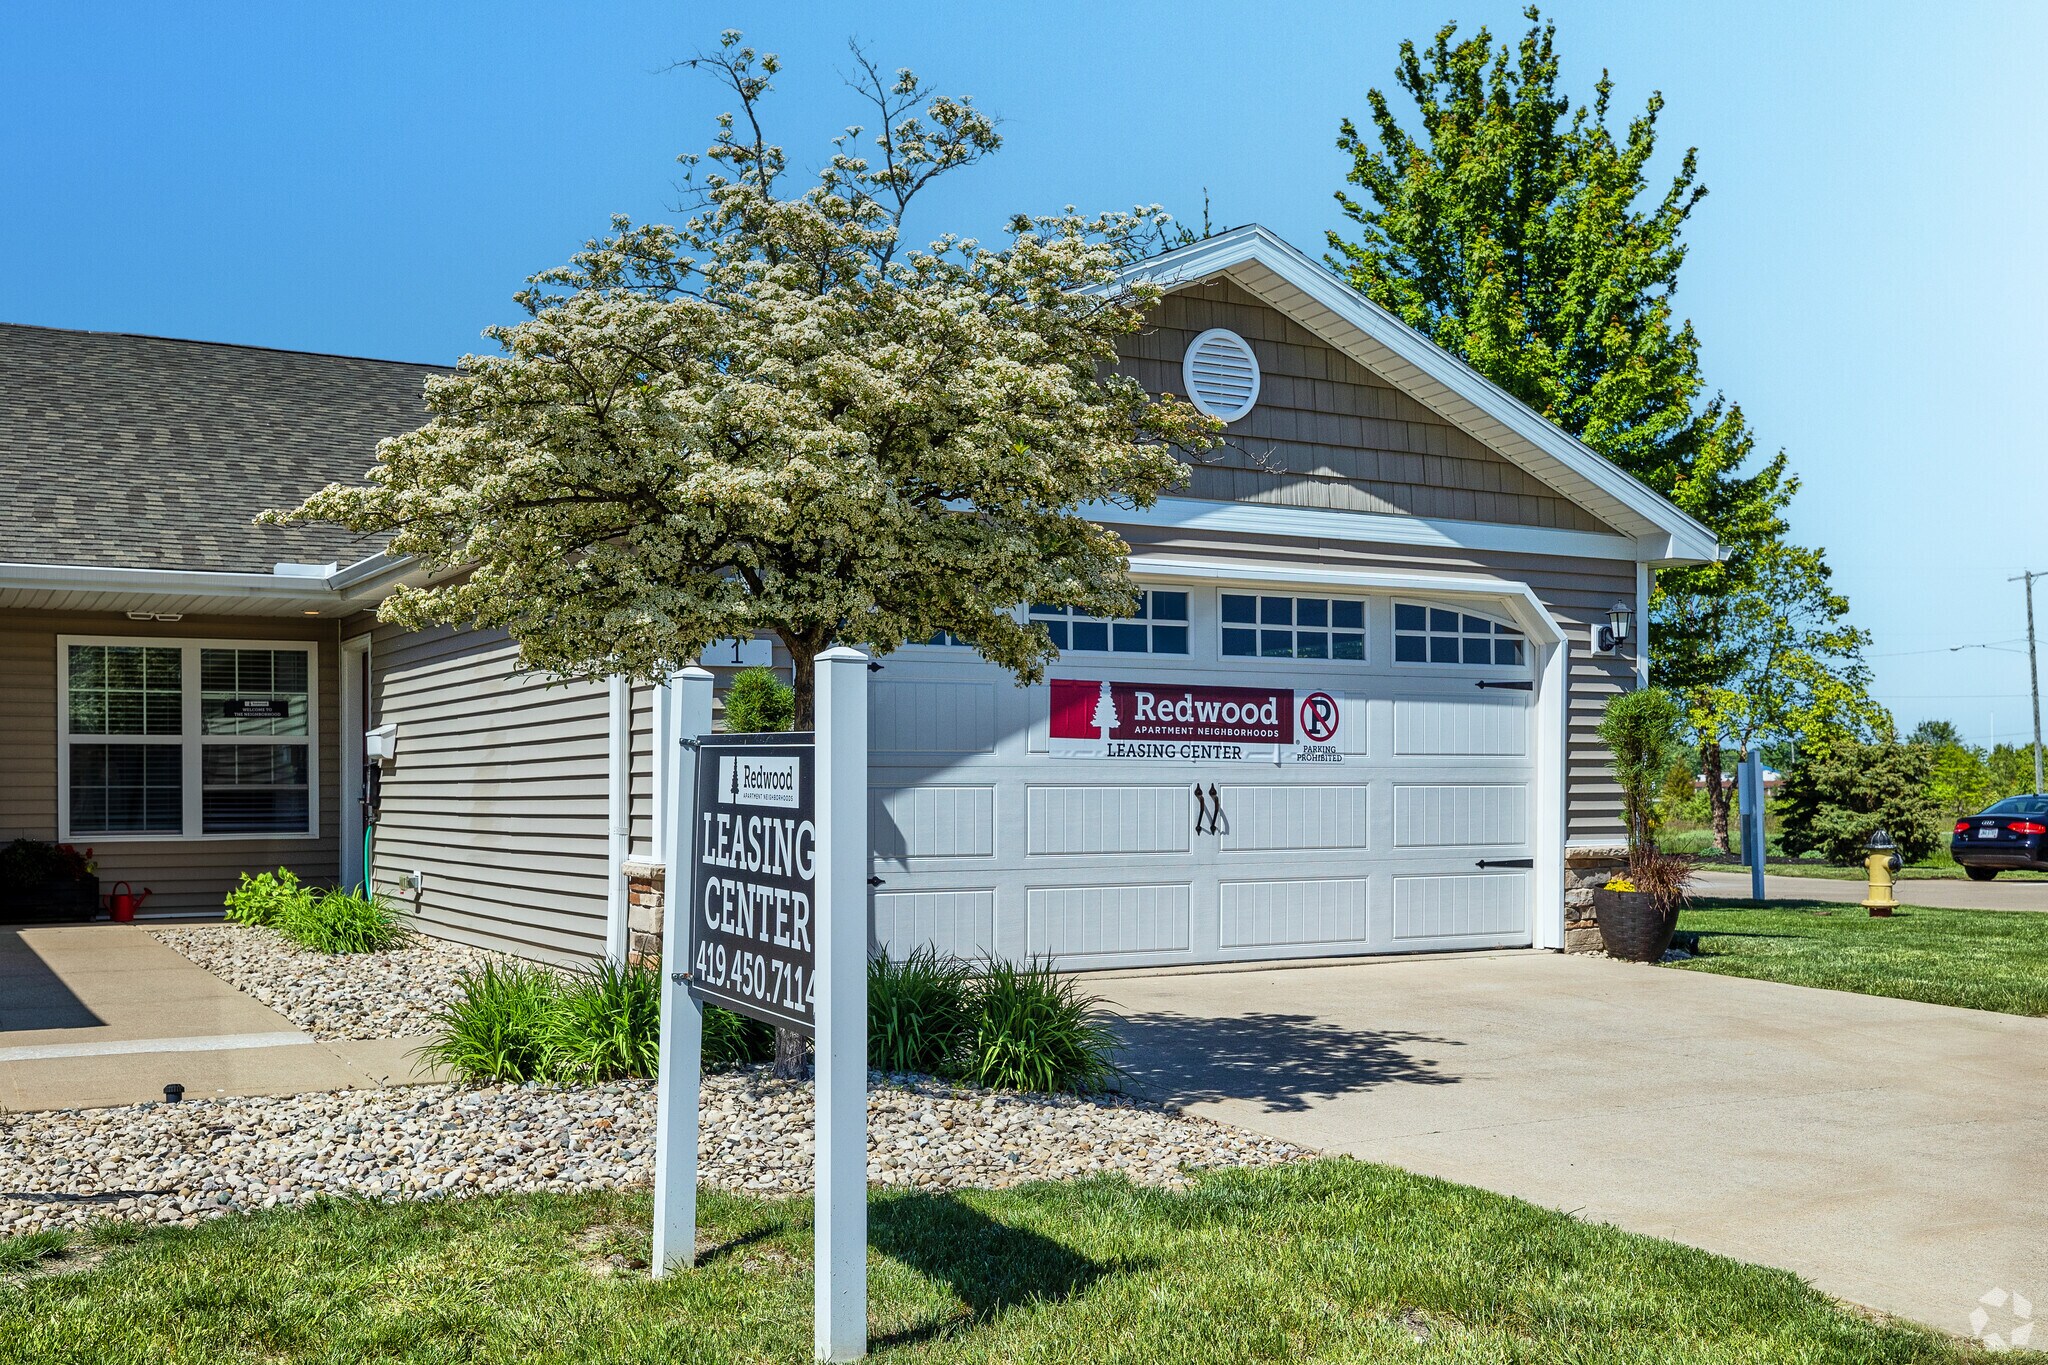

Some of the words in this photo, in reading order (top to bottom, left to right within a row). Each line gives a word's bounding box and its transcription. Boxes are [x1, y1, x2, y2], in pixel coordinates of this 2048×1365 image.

[731, 640, 743, 664] 1
[1134, 691, 1279, 725] Redwood
[1134, 726, 1194, 735] APARTMENT
[1197, 727, 1279, 738] NEIGHBORHOODS
[1106, 742, 1176, 758] LEASING
[1180, 744, 1242, 760] CENTER
[1296, 754, 1342, 762] PROHIBITED
[1303, 745, 1336, 753] PARKING
[743, 764, 793, 791] Redwood
[743, 792, 763, 800] APARTMENT
[763, 794, 793, 802] NEIGHBORHOODS
[702, 812, 815, 881] LEASING
[704, 876, 811, 953] CENTER
[696, 940, 815, 1016] 419.450.7114
